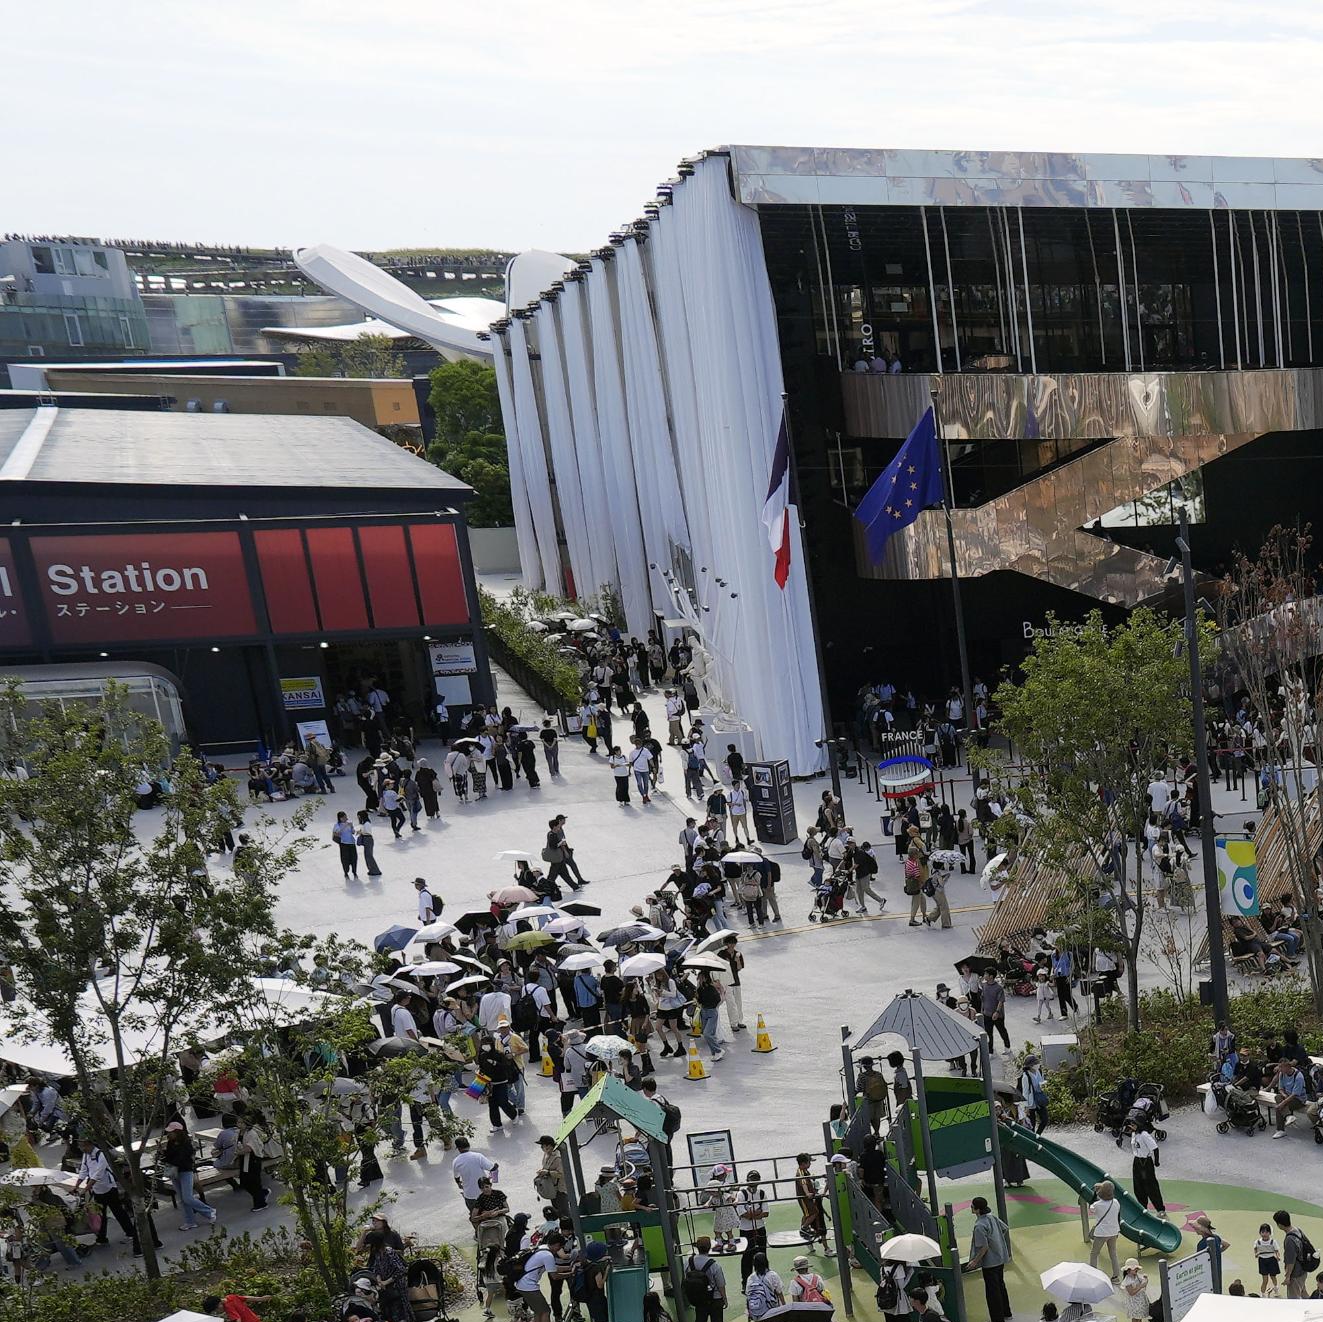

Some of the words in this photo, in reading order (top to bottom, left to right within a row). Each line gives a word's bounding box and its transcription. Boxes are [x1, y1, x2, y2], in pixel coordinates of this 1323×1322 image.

[47, 561, 209, 596] Station
[56, 600, 165, 618] ステーション
[881, 730, 924, 742] FRANCE
